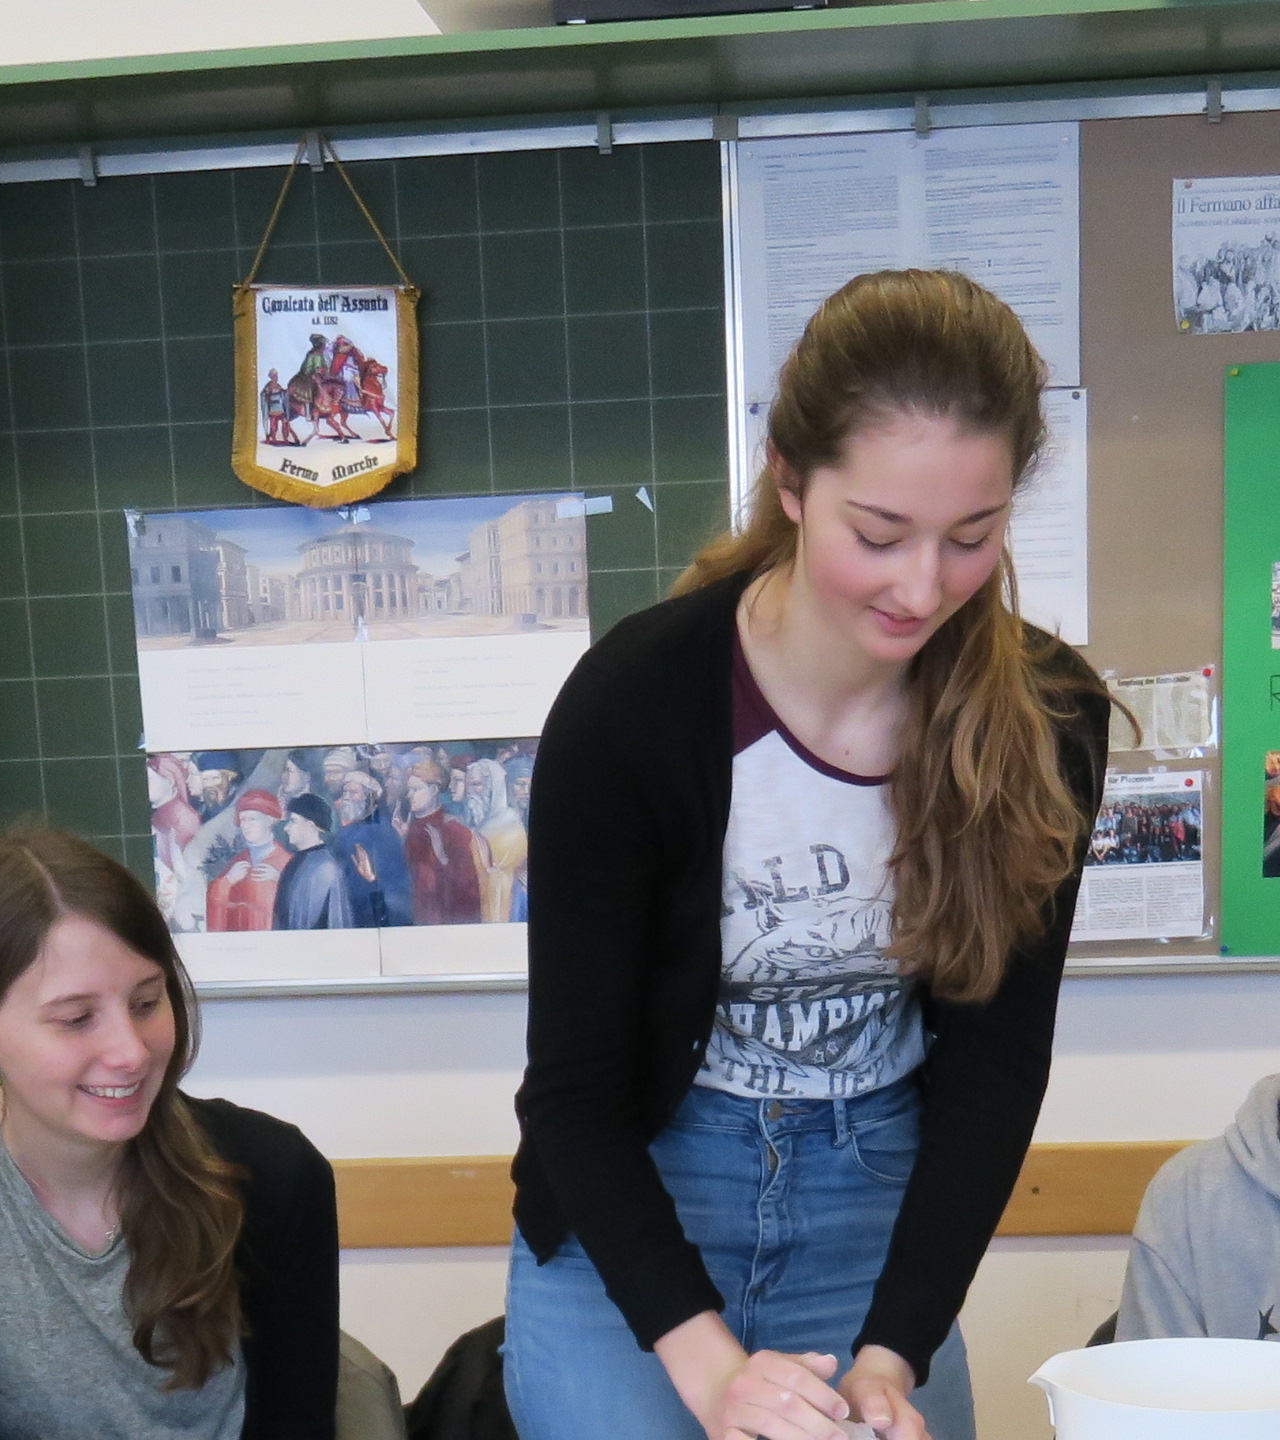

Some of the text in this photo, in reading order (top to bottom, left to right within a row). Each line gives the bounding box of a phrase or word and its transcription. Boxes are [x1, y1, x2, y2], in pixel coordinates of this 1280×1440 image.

[1190, 196, 1252, 213] Fermano
[261, 295, 315, 315] Cavalcata
[341, 294, 389, 313] Assunta
[279, 454, 379, 482] Fermo Marche
